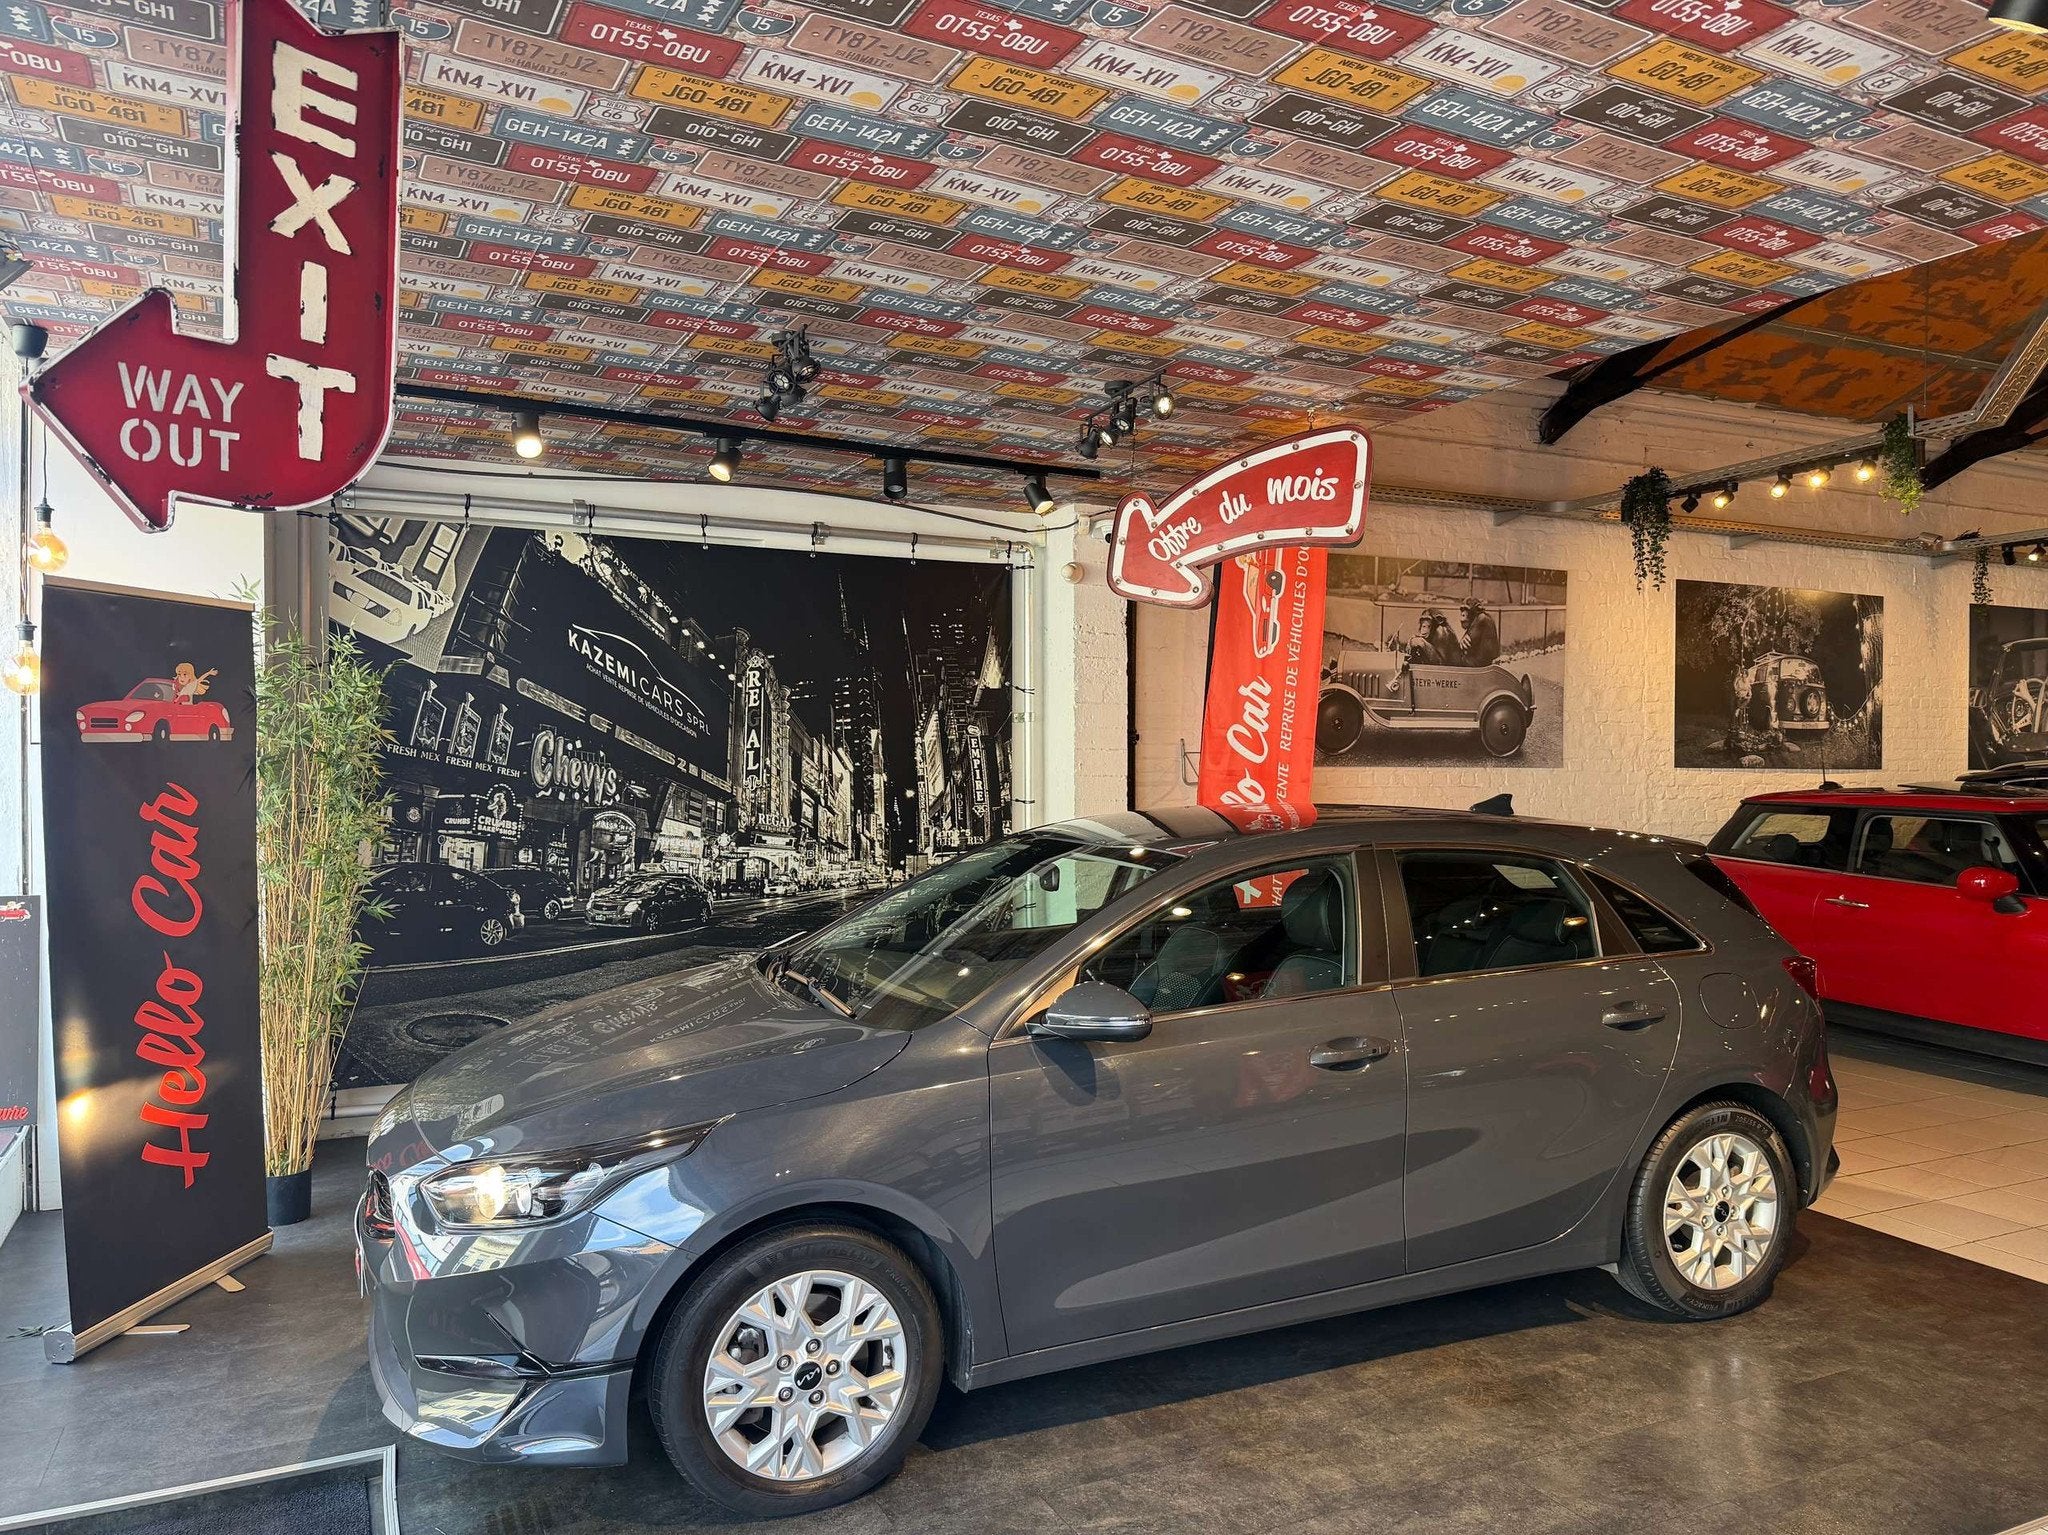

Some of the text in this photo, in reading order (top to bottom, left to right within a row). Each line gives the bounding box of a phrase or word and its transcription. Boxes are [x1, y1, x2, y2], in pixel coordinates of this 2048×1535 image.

[975, 10, 1002, 22] TEXAS
[1102, 7, 1128, 22] 15
[1333, 0, 1360, 12] TEXAS
[73, 27, 96, 42] 15
[409, 19, 429, 34] 15
[625, 19, 653, 31] TEXAS
[751, 16, 773, 30] 15
[1422, 42, 1512, 78] KN4-XV1
[1767, 32, 1854, 69] KN4-XV1
[1086, 53, 1179, 88] KN4-XV1
[1337, 59, 1404, 82] NEW YORK
[1677, 51, 1738, 74] NEW YORK
[122, 72, 226, 105] KN4-XV1
[436, 66, 536, 100] KN4-XV1
[680, 76, 758, 98] NEW YORK
[757, 60, 854, 95] KN4-XV1
[1005, 67, 1077, 89] NEW YORK
[1869, 77, 1896, 88] 66
[1221, 96, 1244, 107] 66
[1542, 87, 1566, 98] 66
[601, 109, 622, 120] 66
[908, 102, 928, 113] 66
[1422, 99, 1513, 131] GEH-142A
[1741, 90, 1828, 123] GEH-142A
[505, 118, 607, 148] GEH-142A
[804, 113, 902, 144] GEH-142A
[1109, 107, 1203, 138] GEH-142A
[1841, 125, 1871, 136] 15
[947, 146, 967, 156] 15
[1239, 142, 1262, 152] 15
[1537, 134, 1563, 145] 15
[661, 151, 679, 161] 15
[942, 177, 1021, 202] KN4-XV1
[1219, 173, 1295, 198] KN4-XV1
[1501, 166, 1575, 192] KN4-XV1
[405, 187, 489, 211] KN4-XV1
[671, 182, 752, 206] KN4-XV1
[1495, 205, 1571, 228] GEH-142A
[1765, 196, 1839, 220] GEH-142A
[715, 219, 799, 241] GEH-142A
[970, 216, 1051, 239] GEH-142A
[1230, 212, 1309, 235] GEH-142A
[266, 39, 359, 462] EXIT
[1075, 263, 1142, 282] KN4-XV1
[1314, 259, 1379, 278] KN4-XV1
[1549, 282, 1614, 300] GEH-142A
[117, 361, 244, 423] WAY
[119, 418, 241, 472] OUT
[1148, 467, 1339, 562] Offre du mois
[1287, 572, 1308, 663] VÉHICULES
[568, 629, 711, 736] KAZEMI CARS SPRL
[1284, 666, 1298, 688] DE
[1413, 678, 1461, 688] TEYR-WERKE-
[746, 670, 762, 771] REGAL
[1225, 675, 1272, 764] Car
[1278, 689, 1298, 752] REPRISE
[387, 743, 520, 778] FRESH MEX FRESH MEX FRESH
[971, 737, 984, 802] EMPIRE
[444, 817, 471, 825] CRUMBS
[478, 815, 518, 830] CRUMBS
[1271, 875, 1283, 906] HAT
[131, 781, 210, 1189] Hello Car
